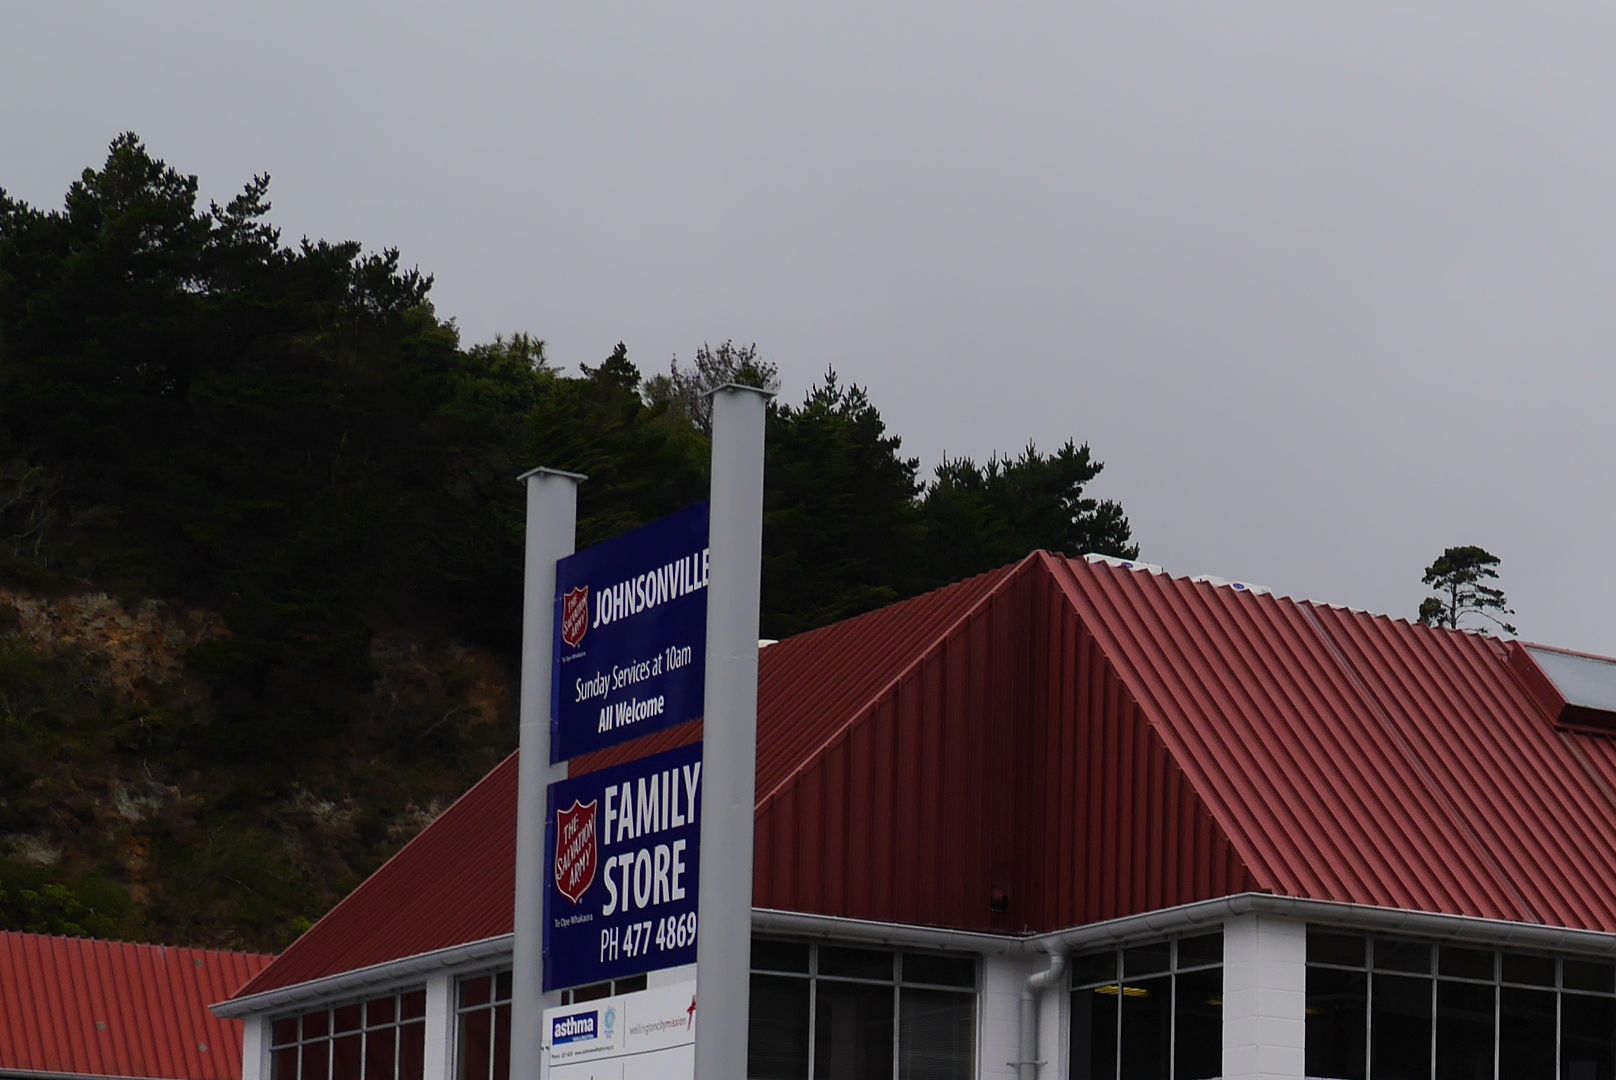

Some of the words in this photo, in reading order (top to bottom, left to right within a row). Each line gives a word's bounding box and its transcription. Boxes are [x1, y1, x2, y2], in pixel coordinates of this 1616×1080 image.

[593, 548, 709, 629] JOHNSONVILLE
[575, 674, 610, 703] Sunday
[612, 660, 650, 691] Services
[652, 656, 663, 676] at
[665, 645, 692, 670] 10am
[598, 708, 613, 733] All
[615, 695, 664, 728] Welcome
[563, 812, 579, 844] THE
[604, 762, 702, 846] FAMILY
[556, 813, 594, 881] SALVATION
[569, 843, 592, 891] ARMY
[602, 838, 687, 917] STORE
[600, 926, 619, 963] PH
[623, 920, 652, 958] 477
[655, 911, 697, 951] 4869
[554, 1017, 594, 1038] asthma
